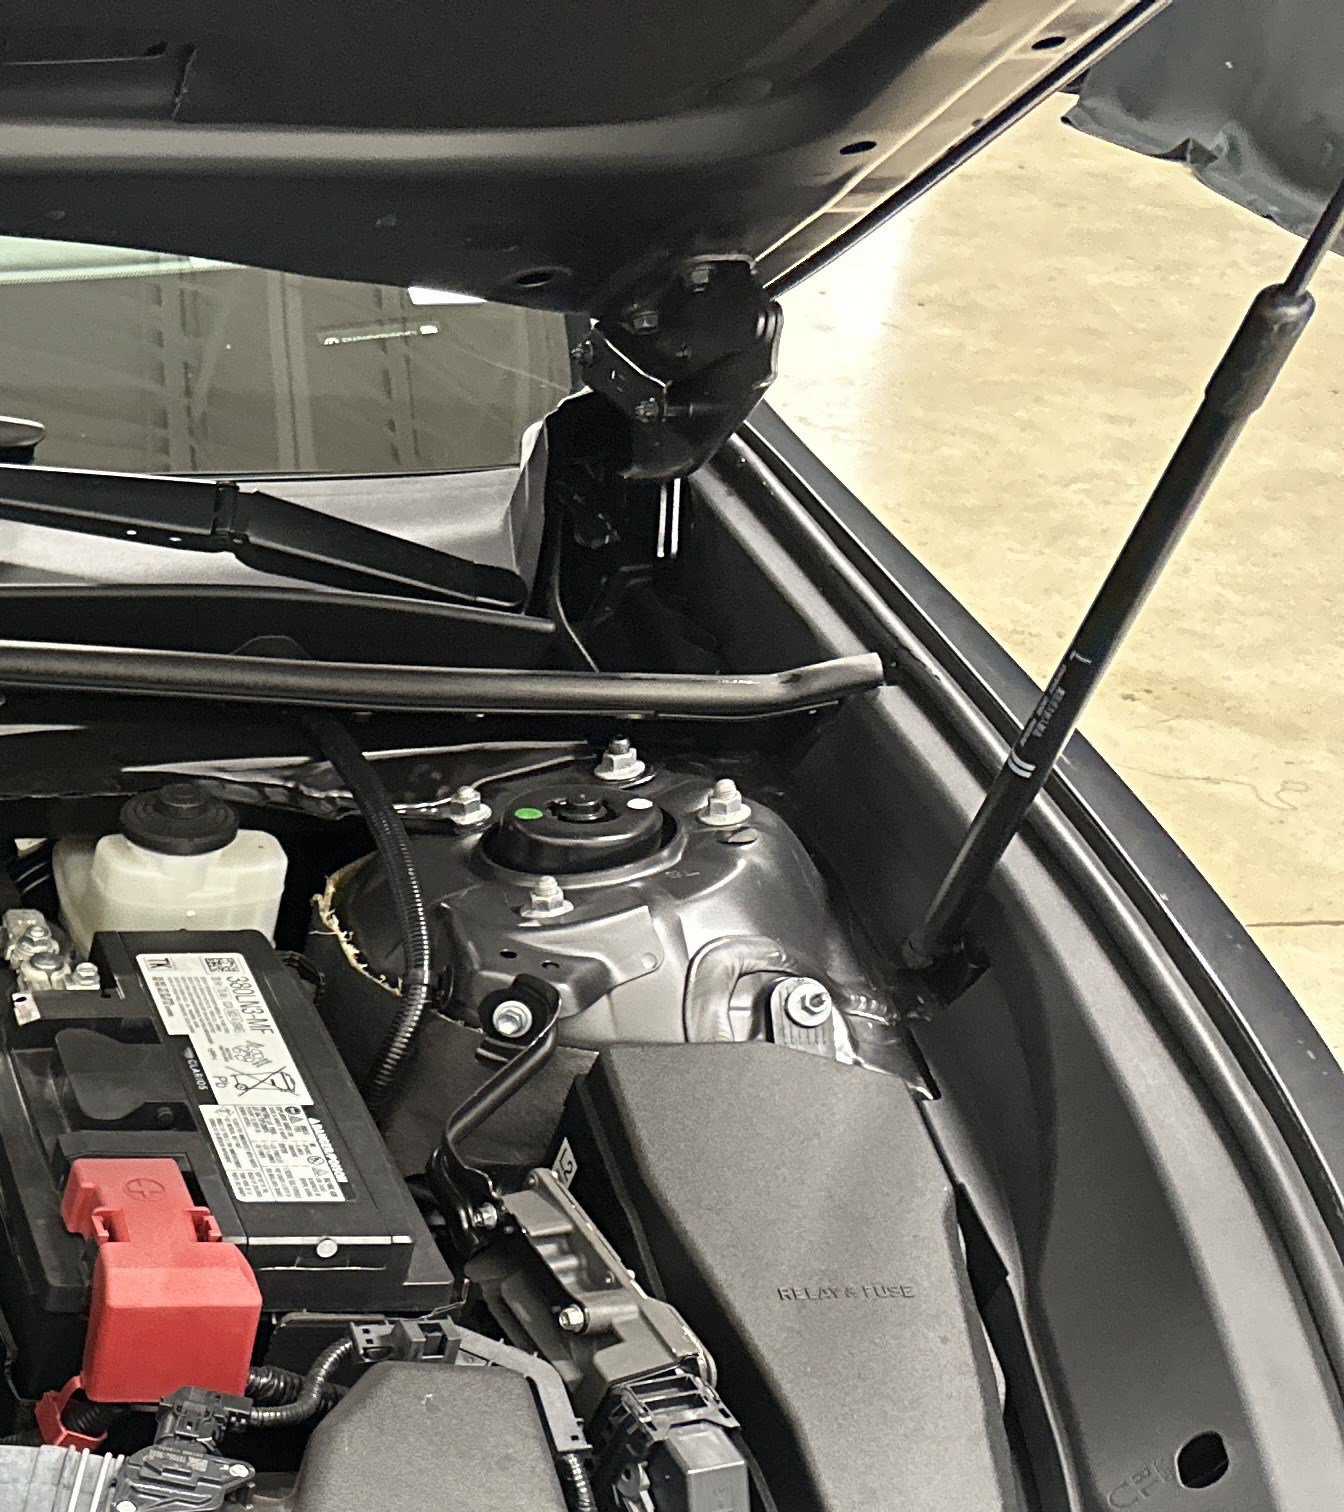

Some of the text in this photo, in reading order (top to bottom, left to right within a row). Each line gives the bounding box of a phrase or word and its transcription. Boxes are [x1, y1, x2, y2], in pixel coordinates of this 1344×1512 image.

[226, 976, 274, 1034] 380LN3-MF
[777, 1287, 839, 1301] RELAY
[862, 1284, 916, 1299] FUSE
